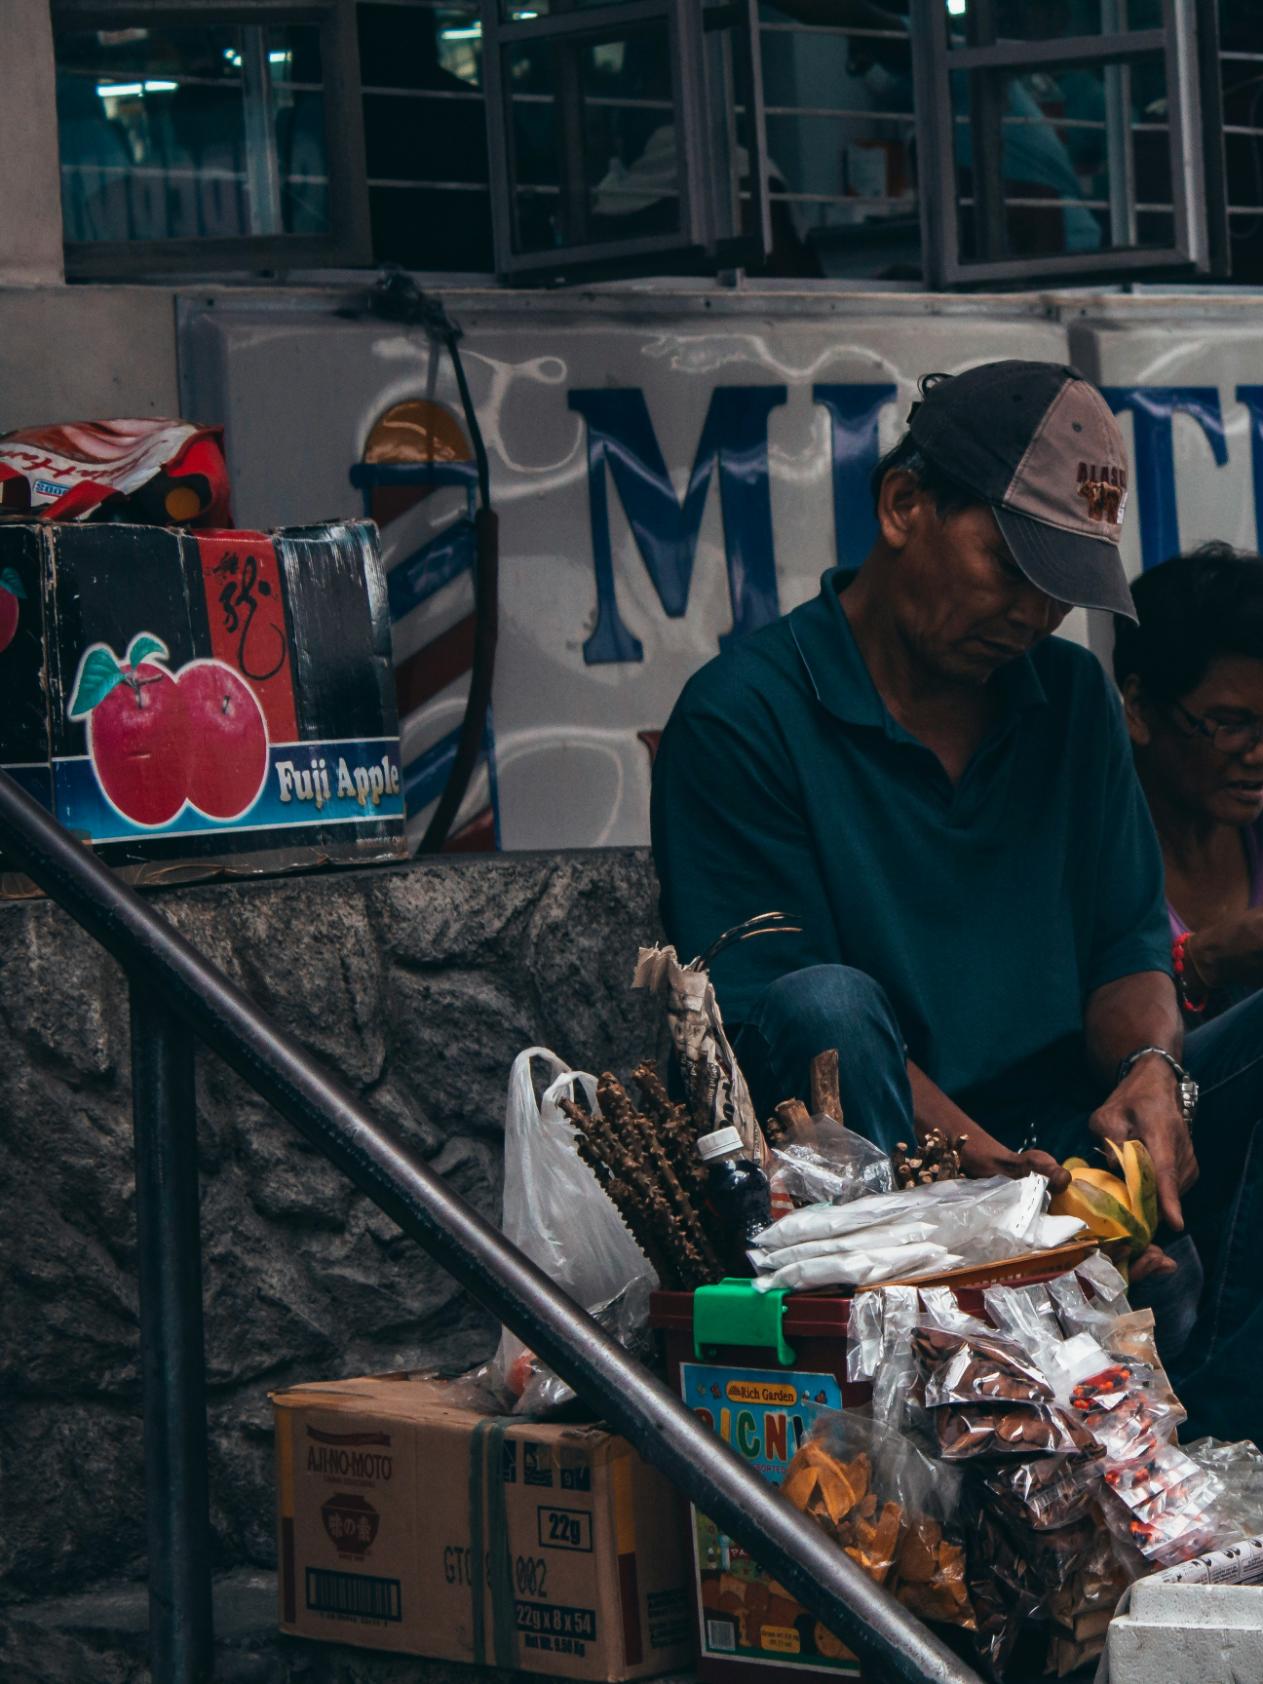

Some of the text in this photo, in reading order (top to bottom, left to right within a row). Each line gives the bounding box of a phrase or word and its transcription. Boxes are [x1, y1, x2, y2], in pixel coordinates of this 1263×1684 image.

[275, 755, 400, 809] Fuji Apple
[741, 1386, 794, 1402] Rich Garden
[307, 1445, 393, 1481] AJI-NO-MOTO
[549, 1511, 582, 1545] 22g
[515, 1604, 592, 1635] 22g x 8 x 54
